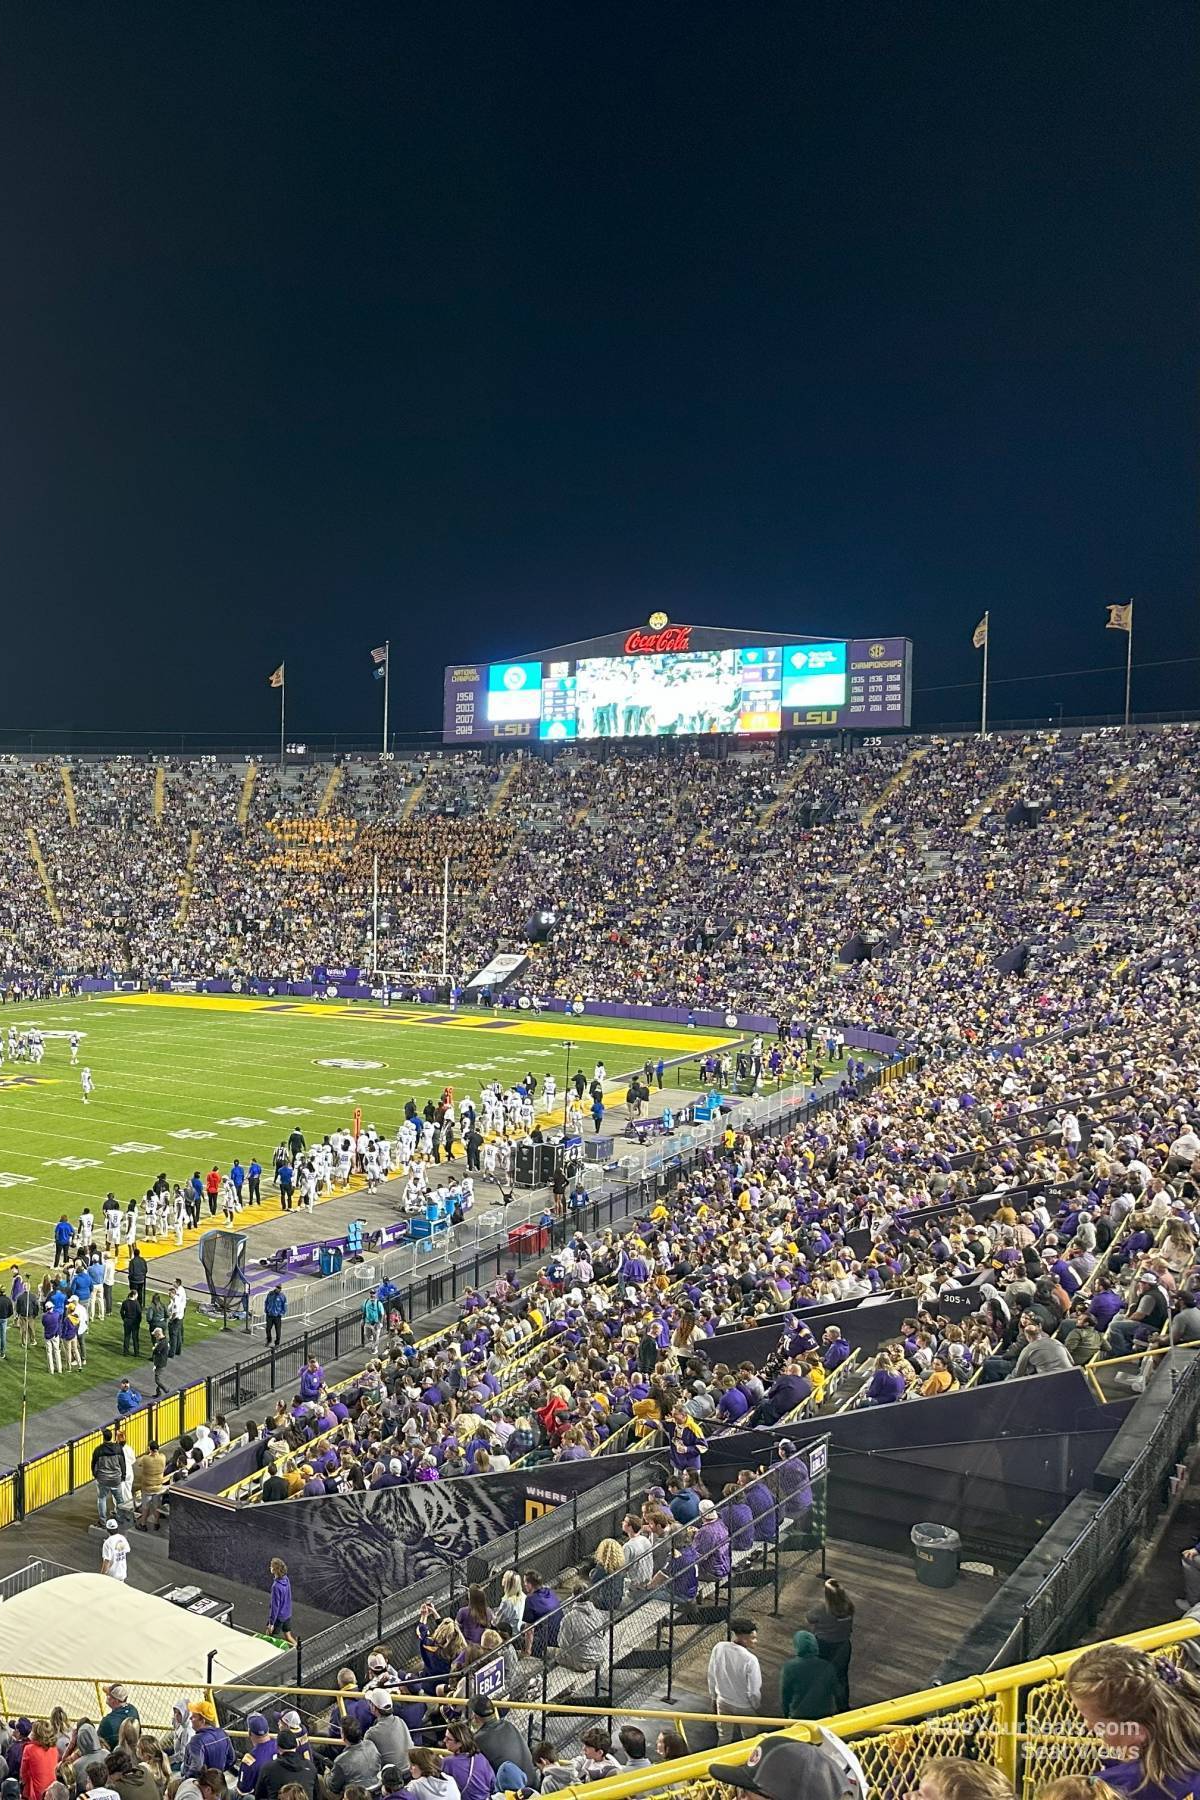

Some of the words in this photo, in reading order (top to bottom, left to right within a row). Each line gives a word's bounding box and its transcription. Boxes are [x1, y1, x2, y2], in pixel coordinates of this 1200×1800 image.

[625, 627, 692, 653] Coca-Cola
[851, 660, 902, 670] CHAMPIONSHIPS
[851, 685, 864, 693] 1961
[456, 692, 473, 701] 1958
[456, 704, 474, 712] 2003
[850, 705, 865, 713] 2007
[869, 704, 882, 712] 2011
[456, 715, 474, 723] 2007
[793, 711, 837, 726] LSU
[456, 726, 472, 734] 2019
[494, 723, 530, 736] LSU
[863, 737, 881, 746] 235
[253, 1004, 523, 1028] LSU
[214, 1116, 268, 1128] 50
[167, 1128, 218, 1140] 45
[110, 1141, 164, 1154] 40
[41, 1156, 104, 1171] 35
[943, 1294, 970, 1305] 305-A
[526, 1486, 567, 1502] WHERE
[189, 1598, 212, 1611] LSU
[480, 1675, 494, 1694] EBL
[495, 1670, 501, 1686] 2
